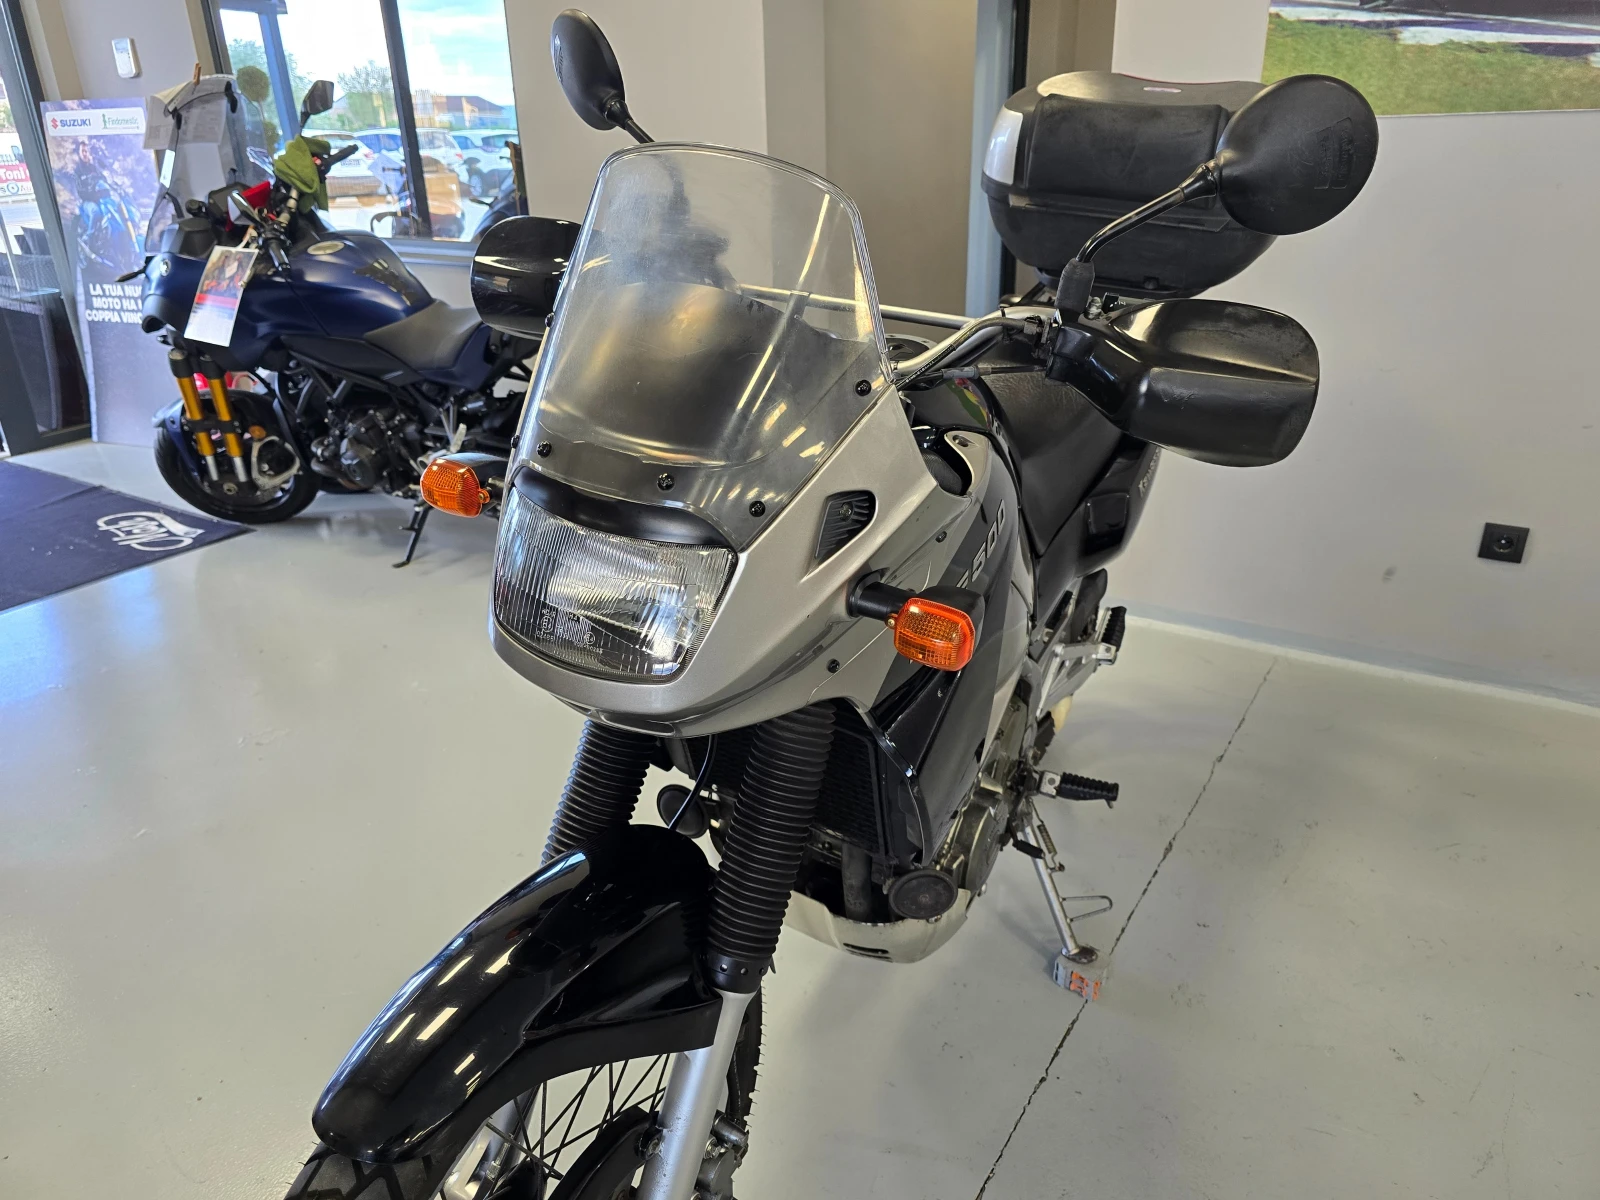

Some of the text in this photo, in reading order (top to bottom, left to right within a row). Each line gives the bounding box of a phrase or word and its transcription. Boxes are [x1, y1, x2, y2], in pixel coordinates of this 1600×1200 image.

[60, 118, 92, 128] SUZUKI
[89, 283, 143, 298] LA TUA NU
[92, 296, 122, 310] MOTO
[121, 298, 138, 311] HA
[85, 308, 143, 324] COPPIA VINC
